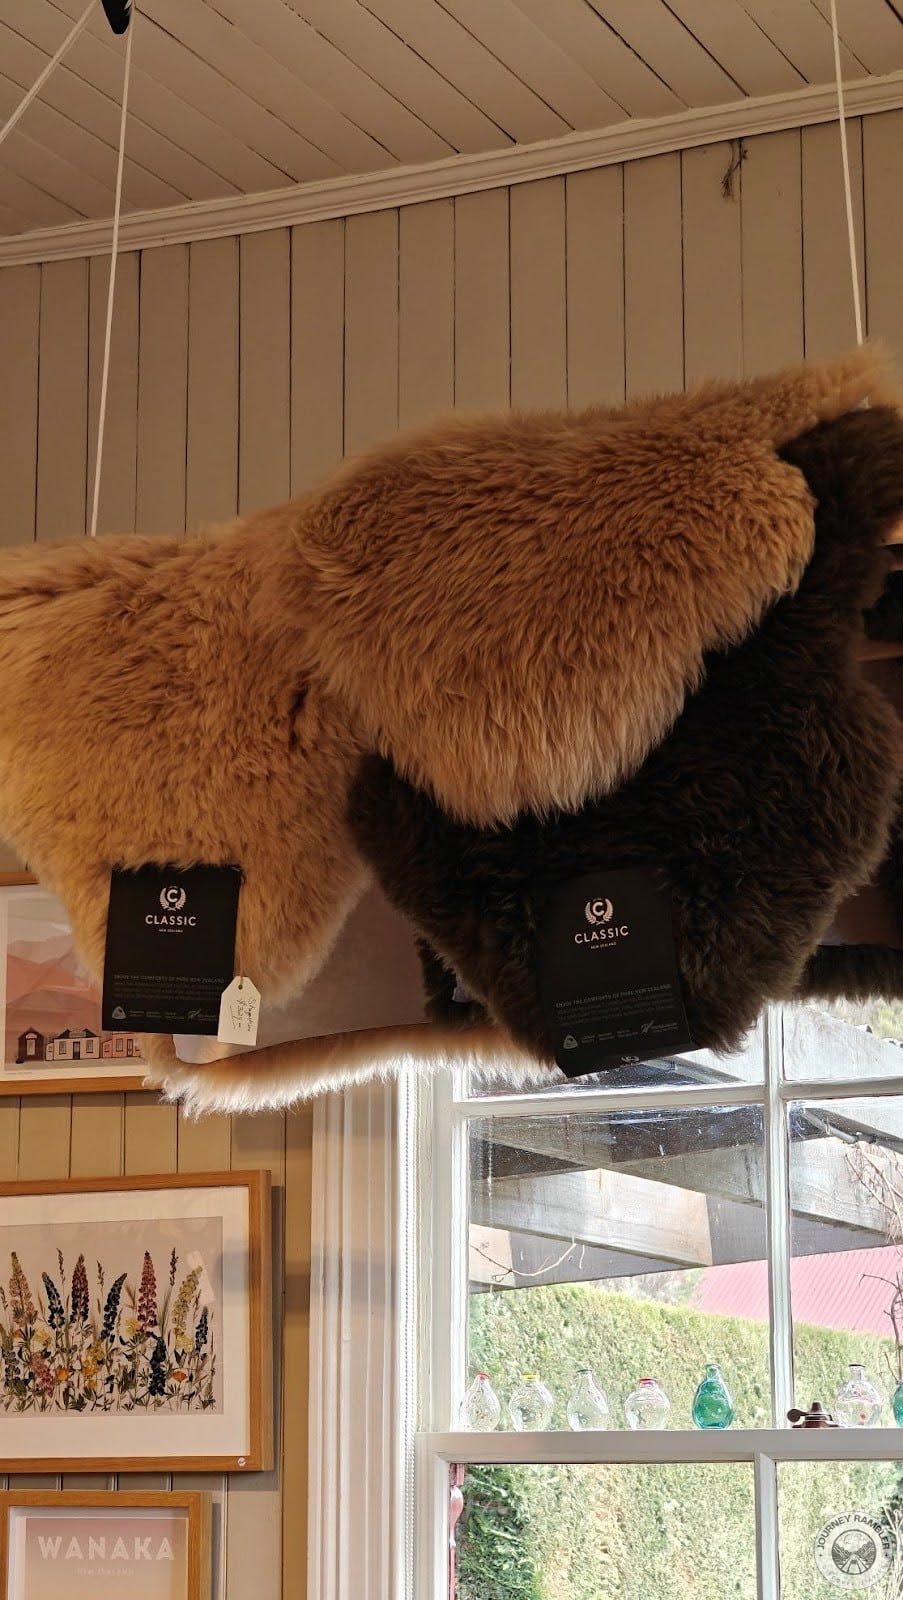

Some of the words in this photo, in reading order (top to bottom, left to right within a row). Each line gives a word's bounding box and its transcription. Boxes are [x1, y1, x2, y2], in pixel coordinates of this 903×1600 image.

[145, 914, 197, 926] CLASSIC
[574, 925, 629, 944] CLASSIC
[37, 1535, 176, 1560] WANAKA
